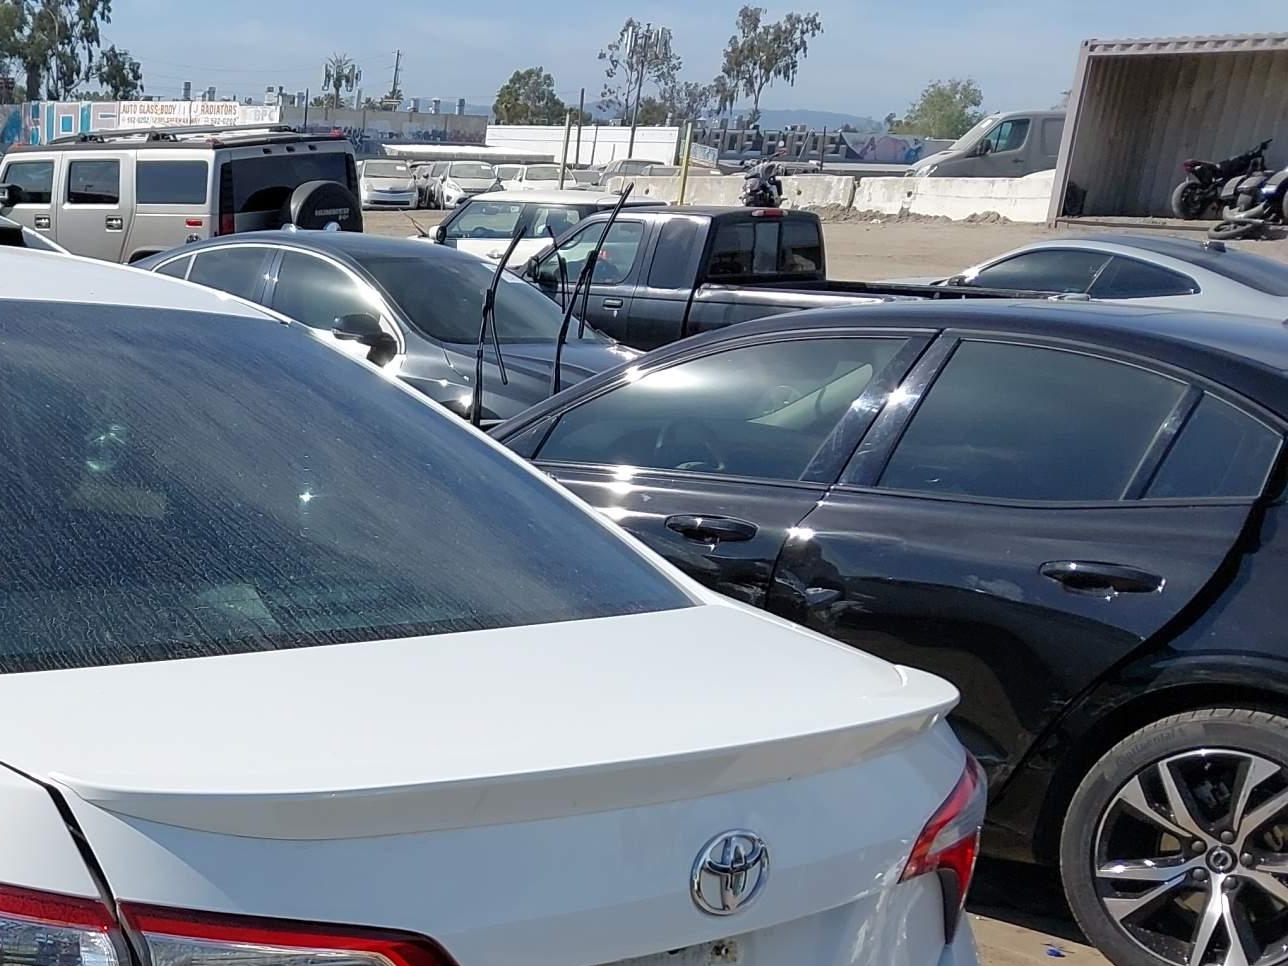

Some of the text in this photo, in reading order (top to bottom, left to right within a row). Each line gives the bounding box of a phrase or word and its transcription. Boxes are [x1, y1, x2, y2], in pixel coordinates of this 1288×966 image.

[122, 104, 177, 114] AUTO GLASS BODY
[200, 104, 238, 115] RADIATORS
